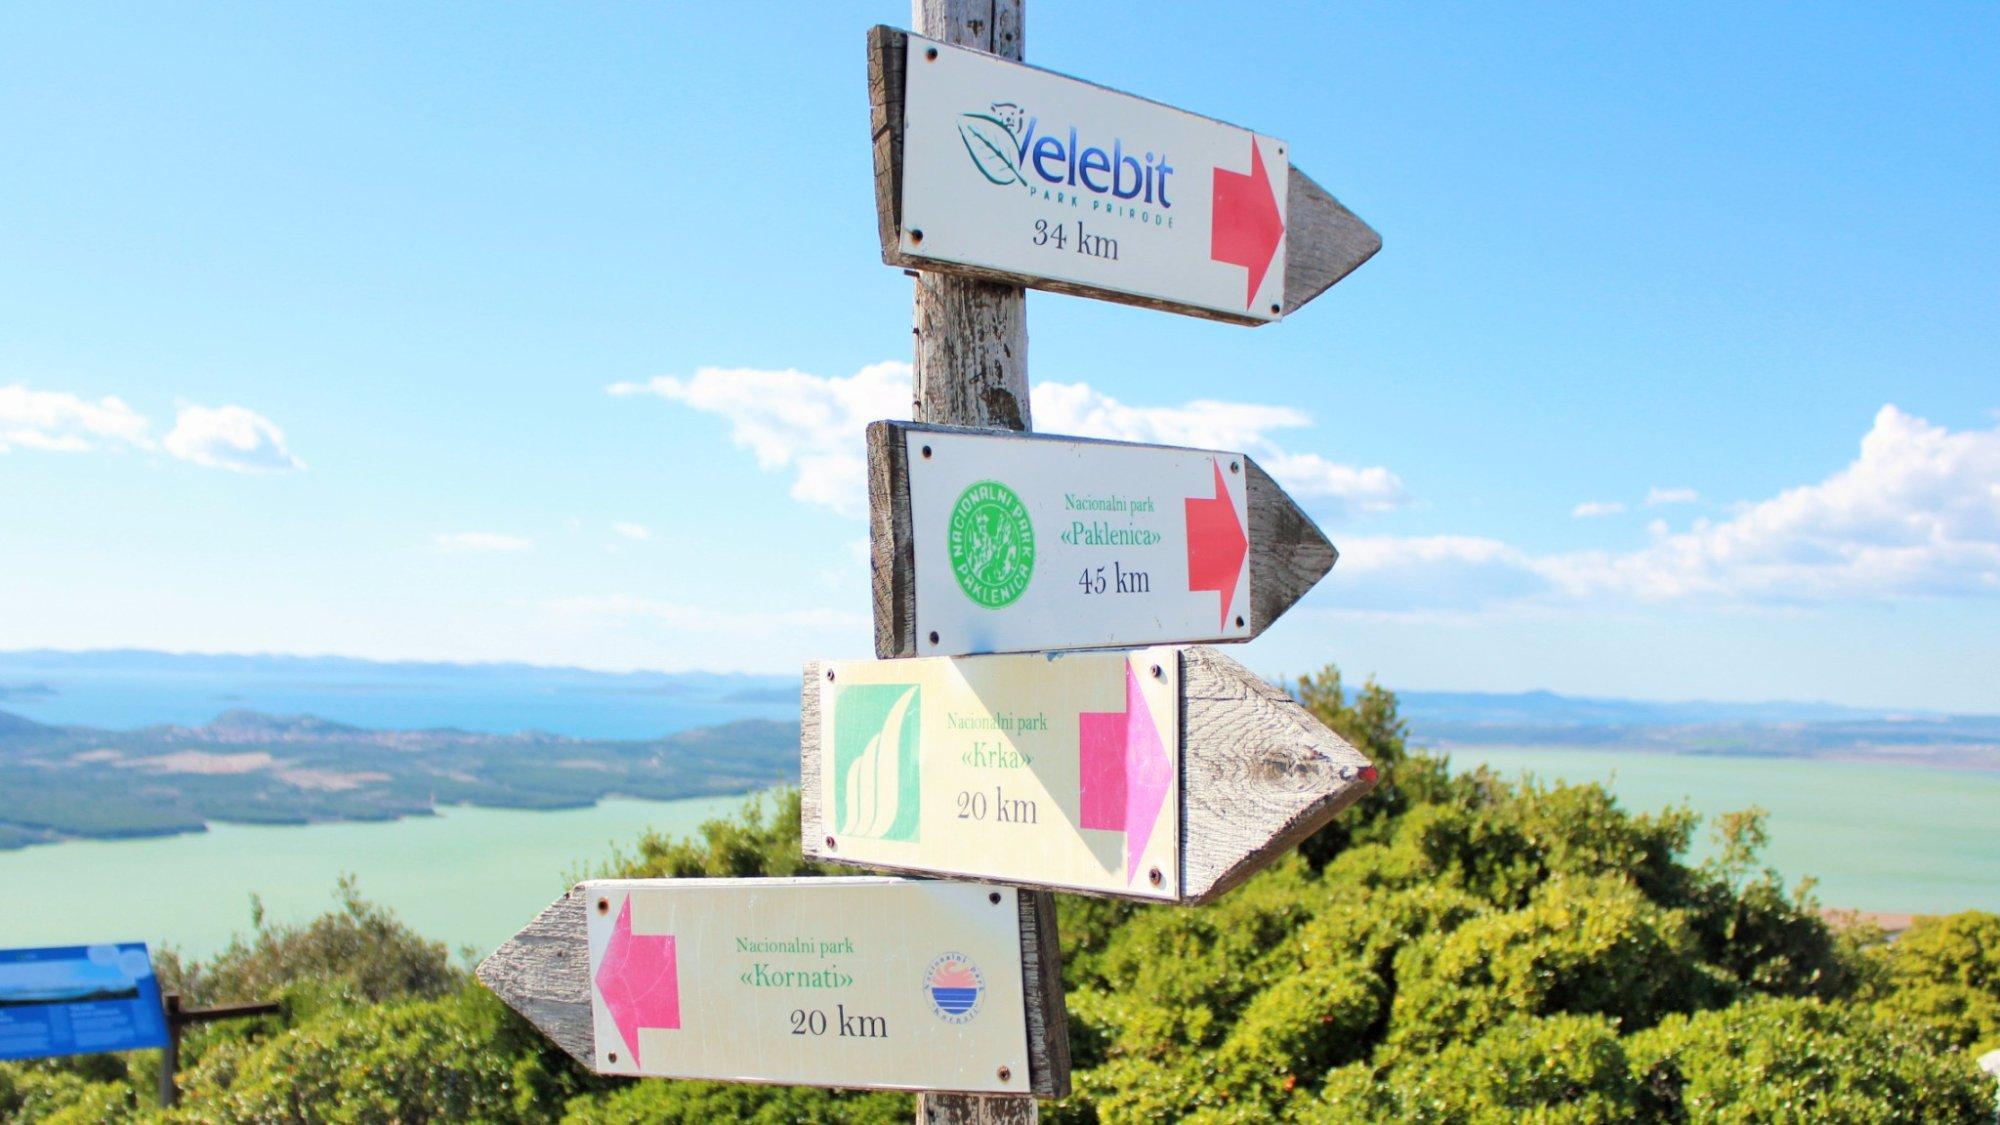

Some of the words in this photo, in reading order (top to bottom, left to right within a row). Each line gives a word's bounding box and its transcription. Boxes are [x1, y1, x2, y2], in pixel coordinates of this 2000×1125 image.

[1016, 116, 1174, 209] Velebit
[1030, 186, 1079, 208] PARK
[1092, 199, 1175, 230] PRIRODE
[1032, 218, 1067, 250] 34
[1076, 220, 1120, 261] km
[1064, 493, 1127, 512] Nacionalni
[1129, 495, 1155, 517] park
[957, 563, 1029, 604] PAKLENICA
[1078, 566, 1107, 595] 45
[1114, 560, 1152, 594] km
[947, 711, 1014, 731] Nacionalni
[1016, 711, 1048, 736] park
[957, 790, 987, 821] 20
[996, 785, 1038, 825] km
[735, 936, 816, 954] Nacionalni
[819, 936, 855, 959] park
[790, 1008, 827, 1036] 20
[836, 1003, 889, 1038] km
